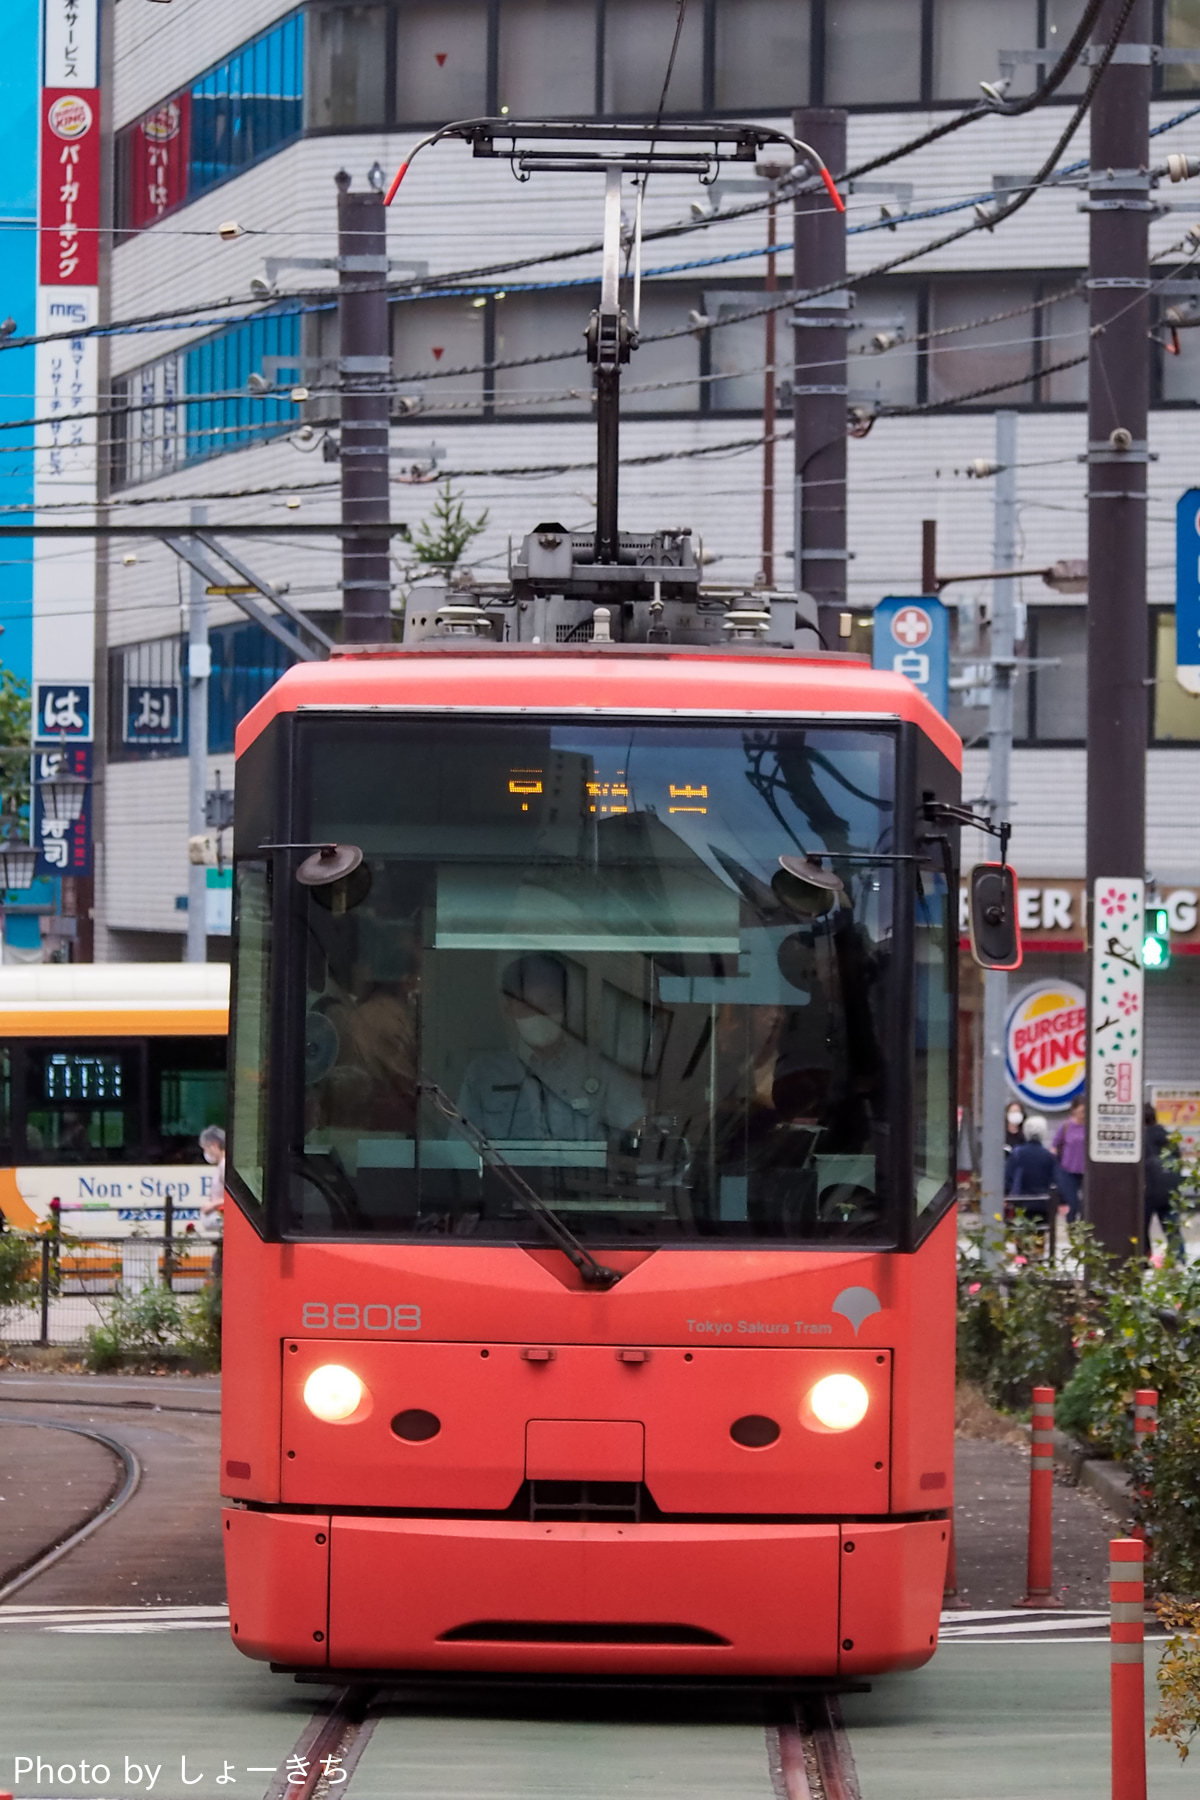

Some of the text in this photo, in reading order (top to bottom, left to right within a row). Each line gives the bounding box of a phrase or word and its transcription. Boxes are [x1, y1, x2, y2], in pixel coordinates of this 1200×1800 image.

[59, 144, 80, 278] バーガーキング
[43, 689, 84, 729] は
[302, 1302, 422, 1331] 8808
[686, 1319, 832, 1336] Tokyo Sakura Tram
